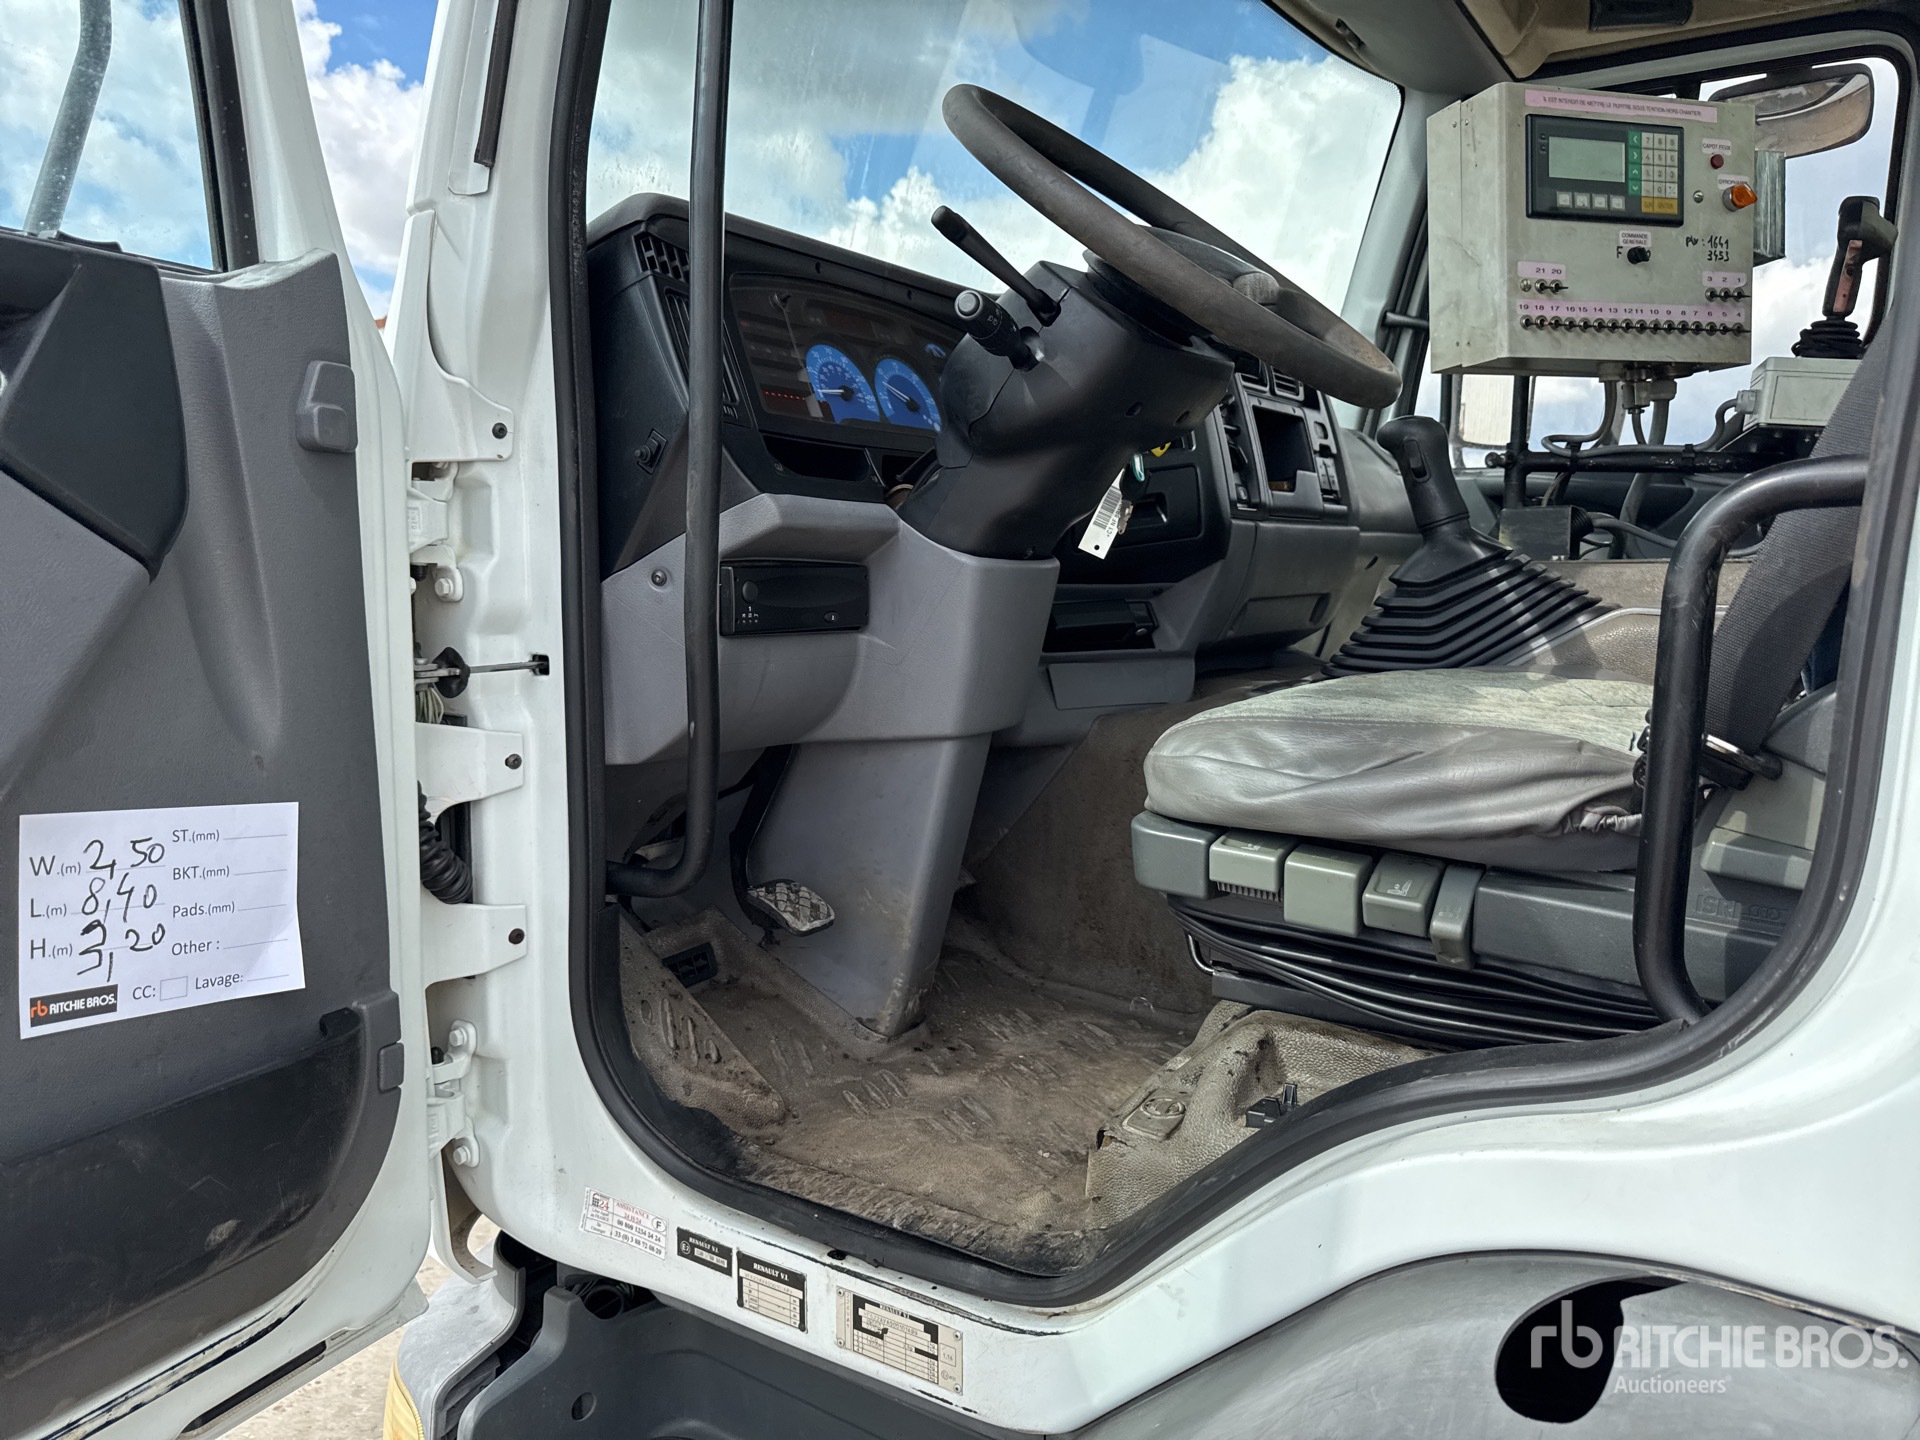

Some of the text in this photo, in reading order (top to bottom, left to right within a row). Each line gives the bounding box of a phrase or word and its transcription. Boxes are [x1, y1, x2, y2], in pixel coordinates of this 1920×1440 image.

[1621, 232, 1649, 240] COMMANDE
[1616, 246, 1624, 259] F
[1535, 267, 1546, 275] 21
[172, 829, 221, 844] ST.(mm)
[29, 855, 82, 877] W.(m)
[172, 866, 231, 881] BKT.(mm)
[29, 898, 68, 918] L.(m)
[172, 903, 236, 919] Pads.(mm)
[29, 938, 73, 960] H.(m)
[171, 940, 213, 957] Other
[194, 972, 244, 990] Lavage:
[132, 986, 157, 1001] CC:
[30, 994, 117, 1019] rb RITCHIE BROS.
[635, 1225, 647, 1236] 1234
[655, 1220, 662, 1229] F
[753, 1262, 790, 1282] RENAULT V.I.
